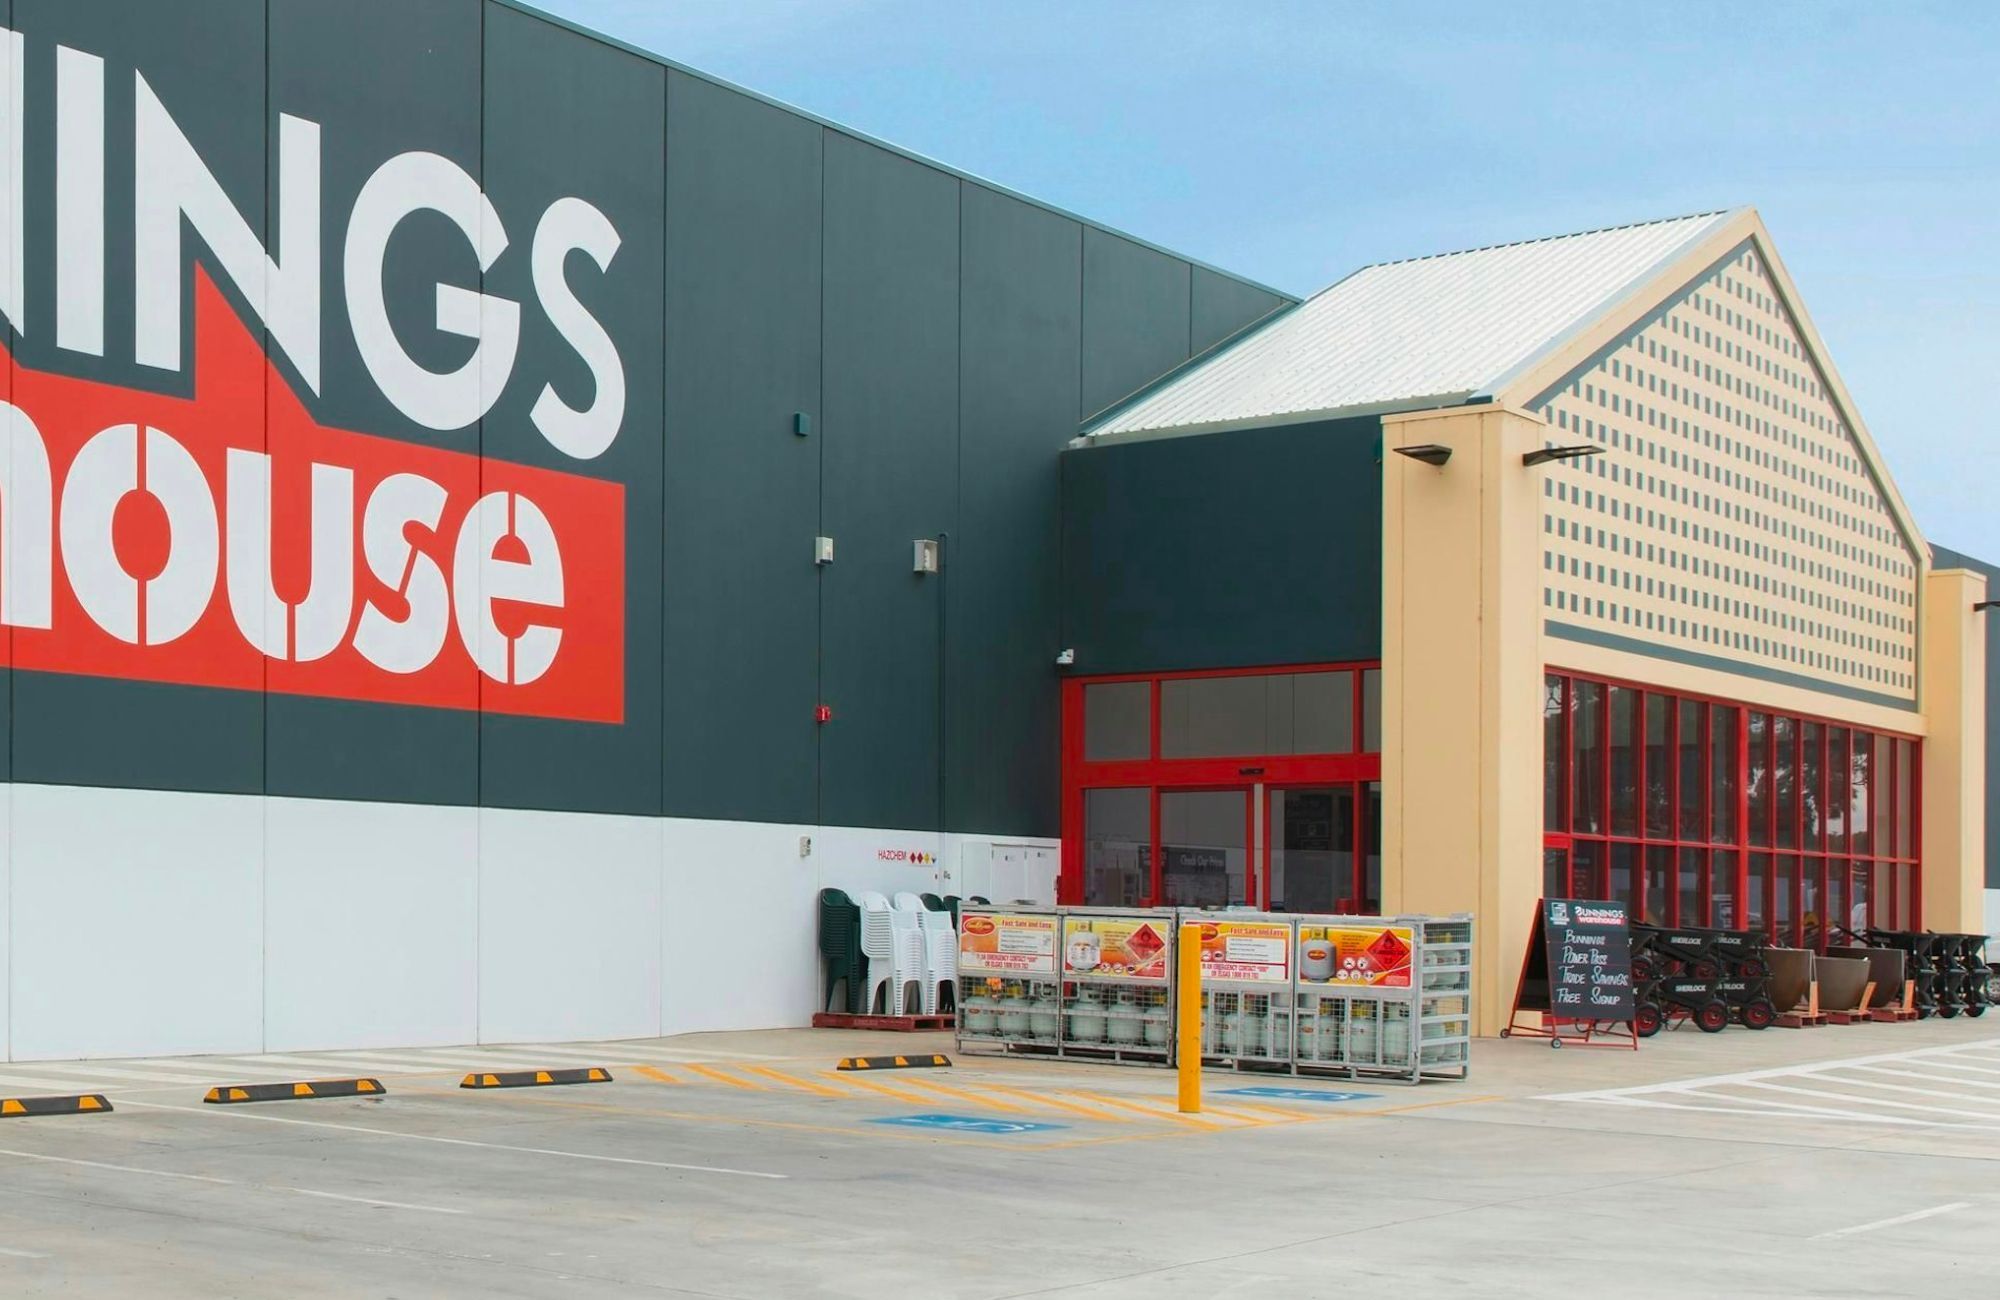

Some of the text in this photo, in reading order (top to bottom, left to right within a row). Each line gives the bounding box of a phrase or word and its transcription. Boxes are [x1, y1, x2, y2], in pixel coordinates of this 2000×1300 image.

[0, 28, 626, 460] INGS
[878, 850, 907, 861] HAZCHEM
[1574, 905, 1624, 919] BUNNINGS
[1578, 916, 1622, 925] warehouse
[1670, 936, 1702, 945] SHERLOCK
[1558, 965, 1586, 985] TRADE
[1675, 984, 1706, 992] SHERLOCK
[1556, 987, 1581, 1004] FREE
